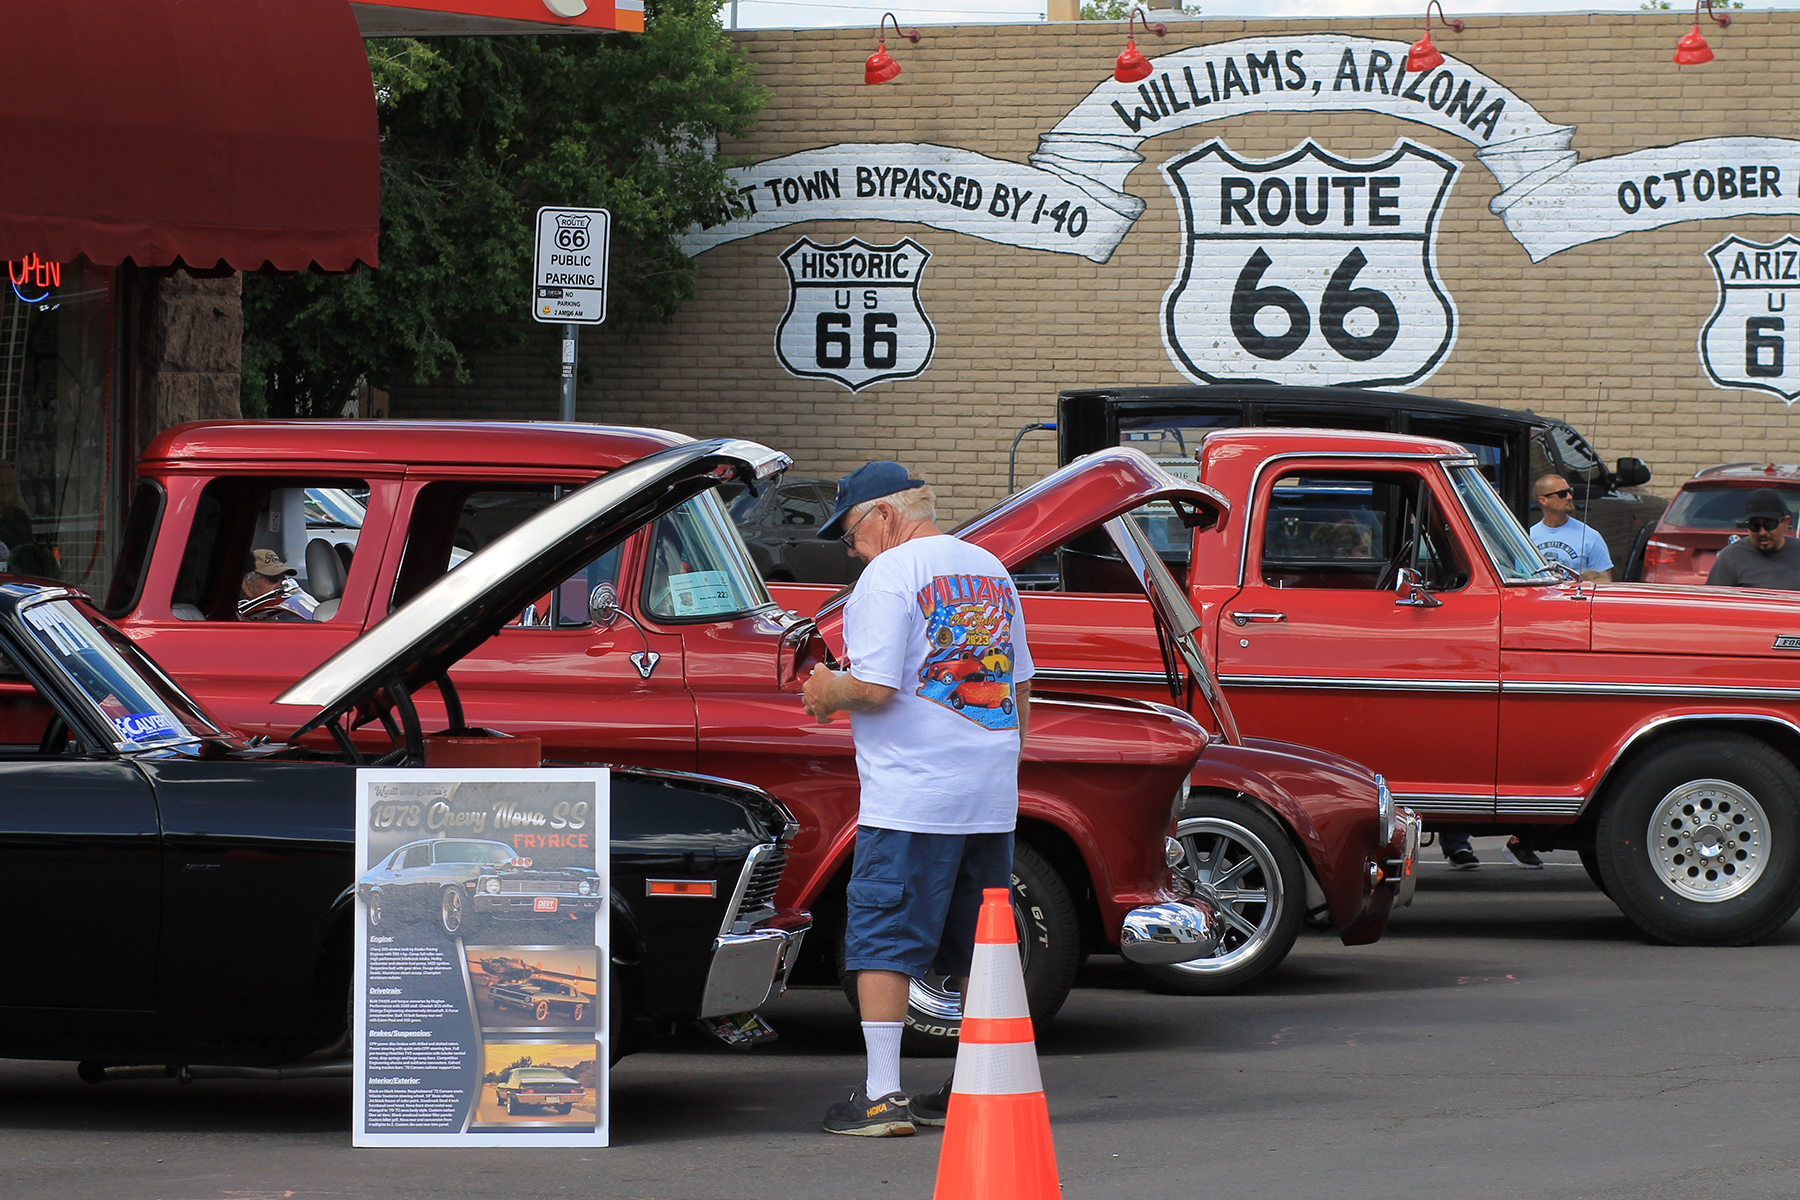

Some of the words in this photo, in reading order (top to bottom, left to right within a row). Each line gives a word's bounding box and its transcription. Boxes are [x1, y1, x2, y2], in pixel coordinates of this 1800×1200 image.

[1111, 48, 1322, 133] WILLIAMS,
[1332, 47, 1506, 141] ARIZONA
[1617, 165, 1782, 215] OCTOBER
[764, 168, 841, 207] TOWN
[856, 166, 983, 211] BYPASSED
[988, 184, 1036, 222] BY
[1031, 194, 1089, 238] I-40
[1220, 176, 1401, 227] ROUTE
[559, 229, 585, 248] 66
[8, 252, 60, 287] OPEN
[551, 254, 592, 267] PUBLIC
[801, 252, 909, 279] HISTORIC
[545, 273, 595, 286] PARKING
[1230, 246, 1400, 361] 66
[815, 312, 898, 370] 66
[917, 574, 1015, 619] WILLIAMS
[965, 634, 990, 646] 2023
[123, 714, 173, 735] CALVERT
[374, 785, 399, 798] Wyatt
[399, 787, 415, 796] and
[417, 786, 448, 796] Emma's
[374, 804, 421, 828] 1973
[427, 800, 487, 833] Chevy
[492, 800, 547, 829] Nova
[550, 801, 589, 830] SS
[513, 833, 589, 848] FRYRICE
[1030, 906, 1049, 948] G/T
[369, 935, 394, 943] Engine:
[369, 987, 402, 995] Drivetrain:
[368, 1029, 433, 1038] Brakes/Suspension:
[368, 1077, 421, 1085] Interior/Exterior:
[866, 1103, 888, 1118] HOKA
